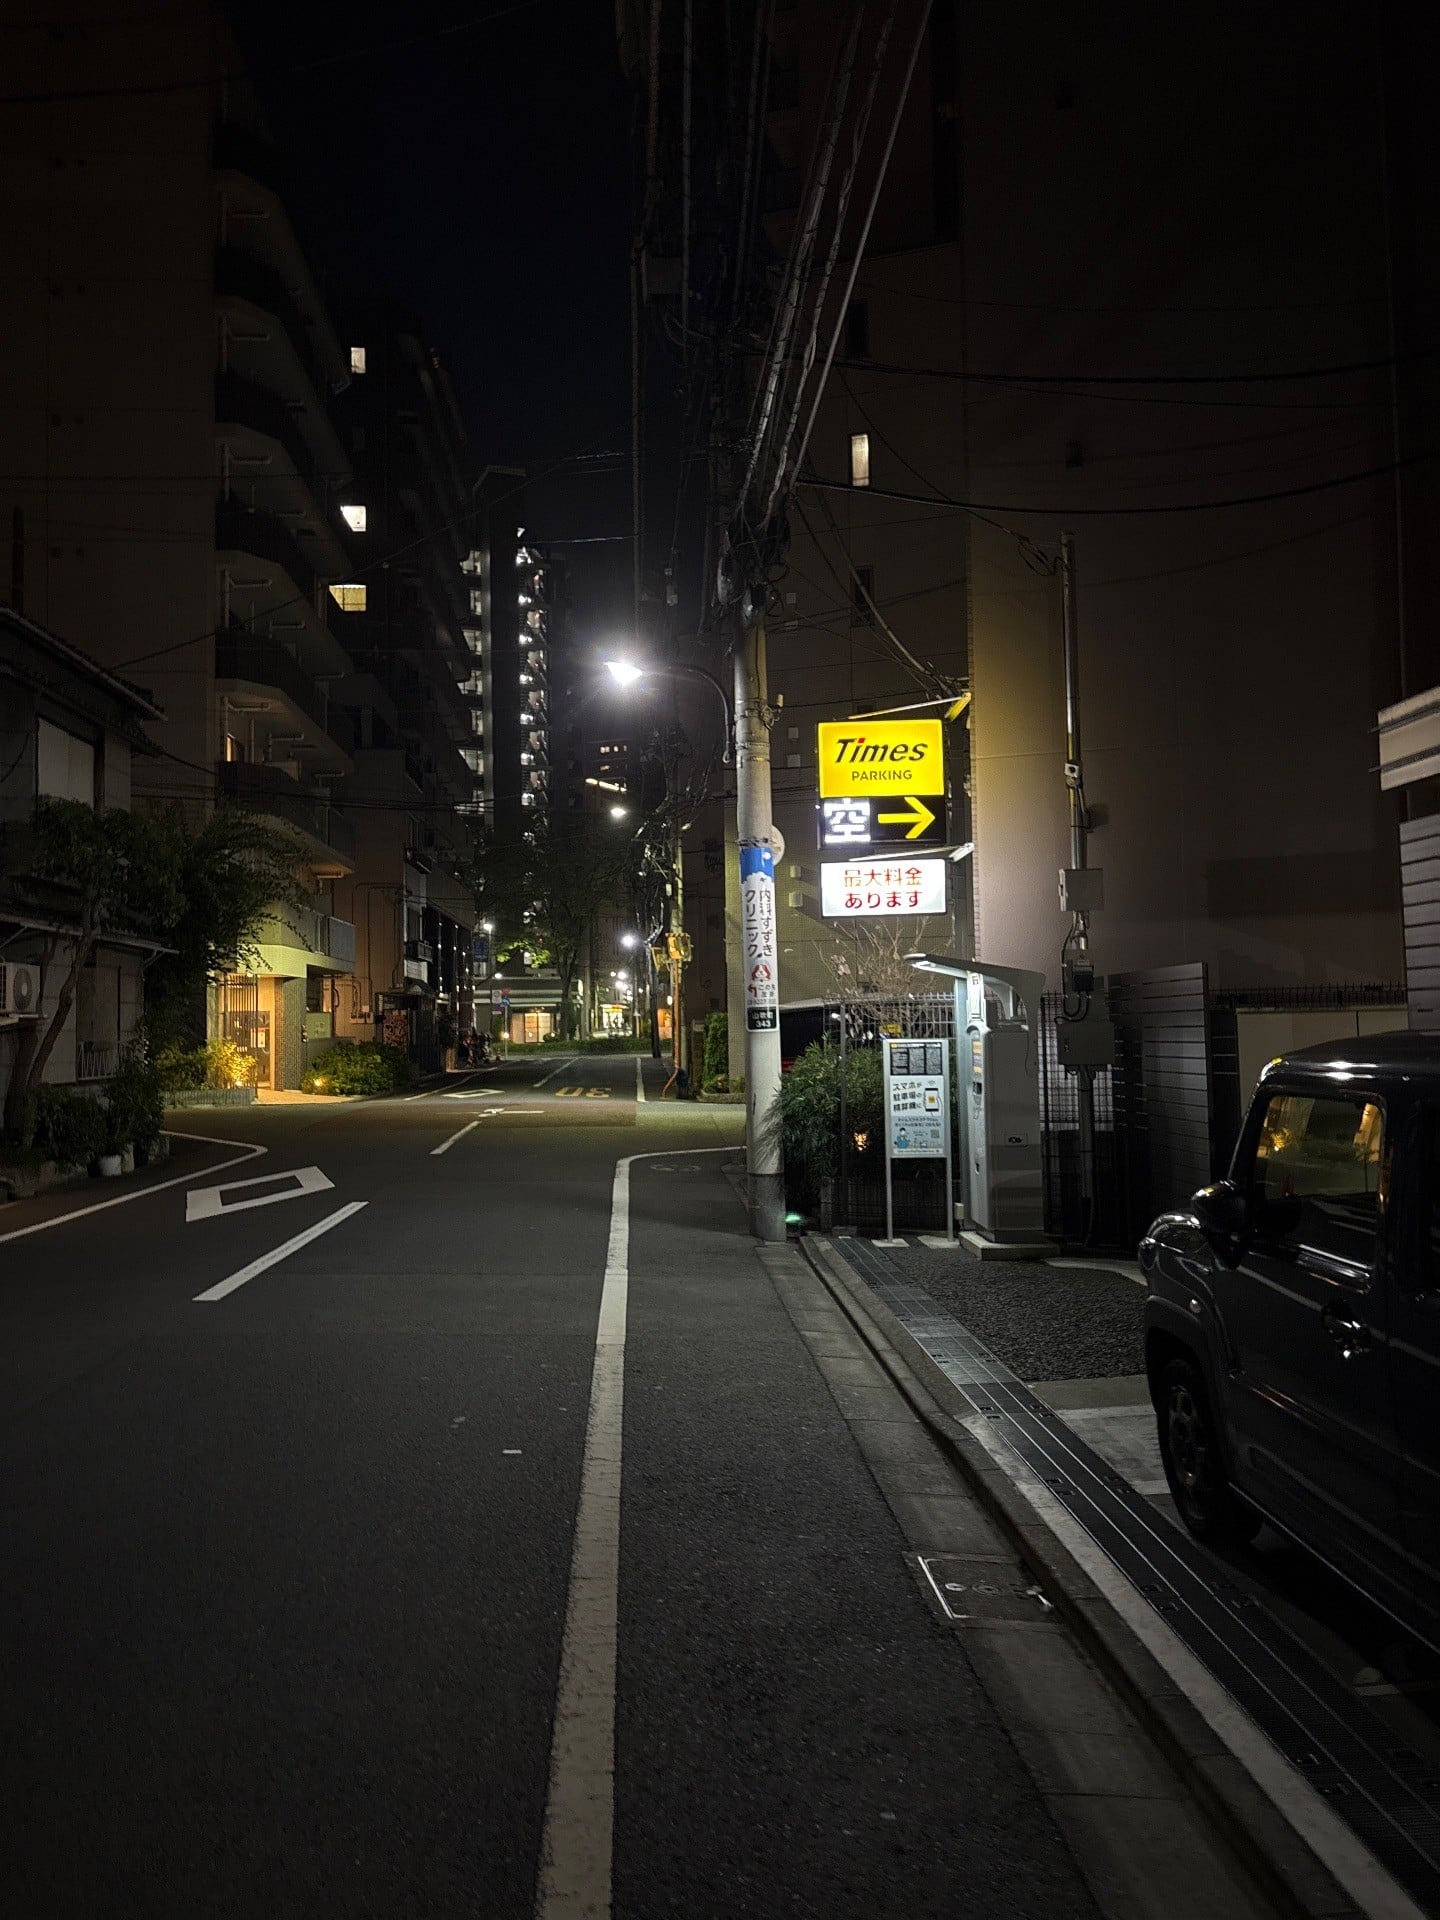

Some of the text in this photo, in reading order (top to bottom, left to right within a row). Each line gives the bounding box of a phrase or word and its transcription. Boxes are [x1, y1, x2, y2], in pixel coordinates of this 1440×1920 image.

[835, 738, 928, 764] Times
[851, 769, 913, 782] PARKING
[824, 797, 871, 843] 空
[844, 867, 922, 888] 最大料金
[844, 890, 922, 909] あります
[745, 889, 758, 958] クリニック
